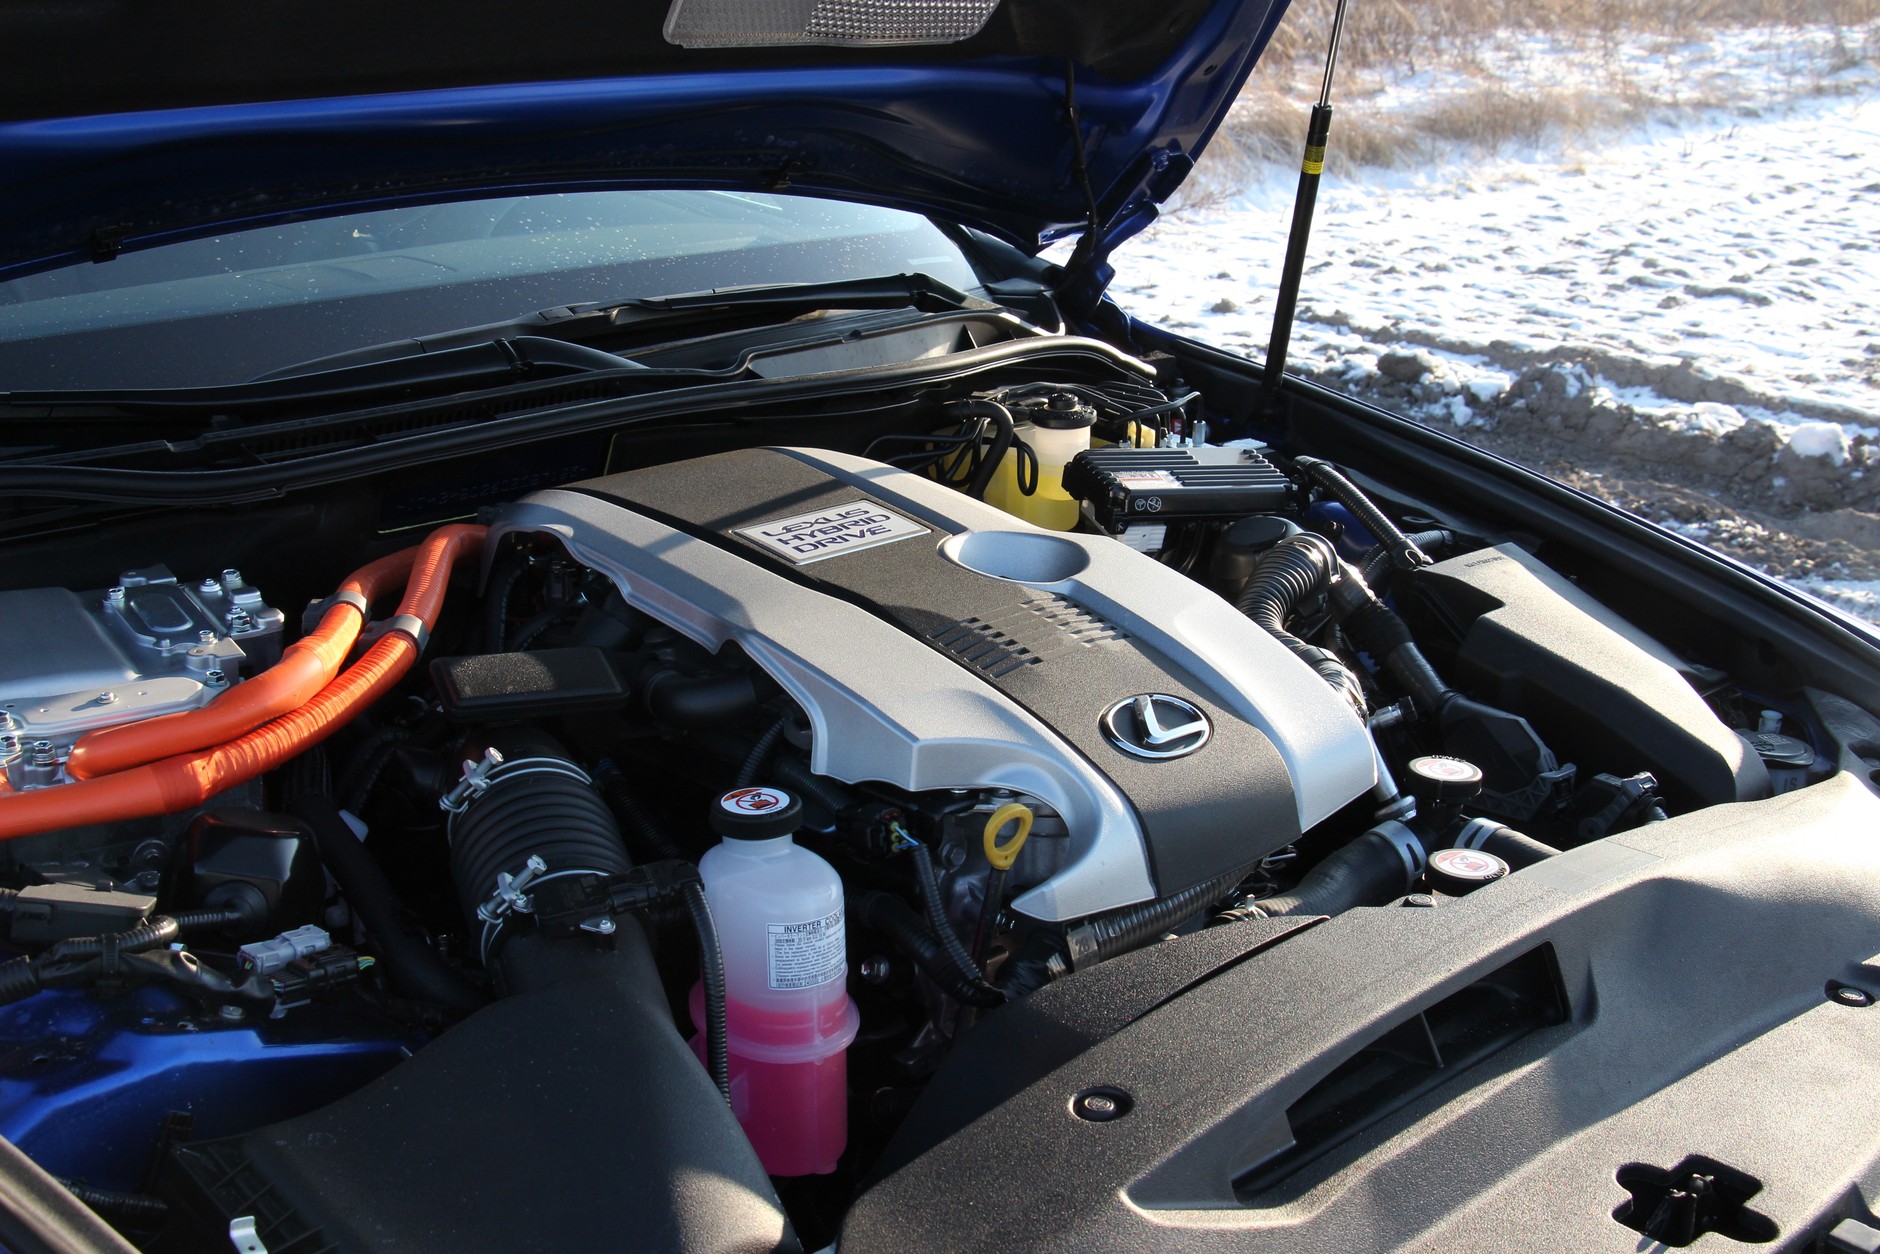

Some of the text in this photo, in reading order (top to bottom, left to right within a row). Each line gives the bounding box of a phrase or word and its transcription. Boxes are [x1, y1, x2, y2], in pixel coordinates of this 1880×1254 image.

[761, 508, 870, 537] LEXUS
[776, 514, 891, 545] HYBRID
[791, 525, 892, 554] DRIVE
[784, 920, 822, 933] INVERTER
